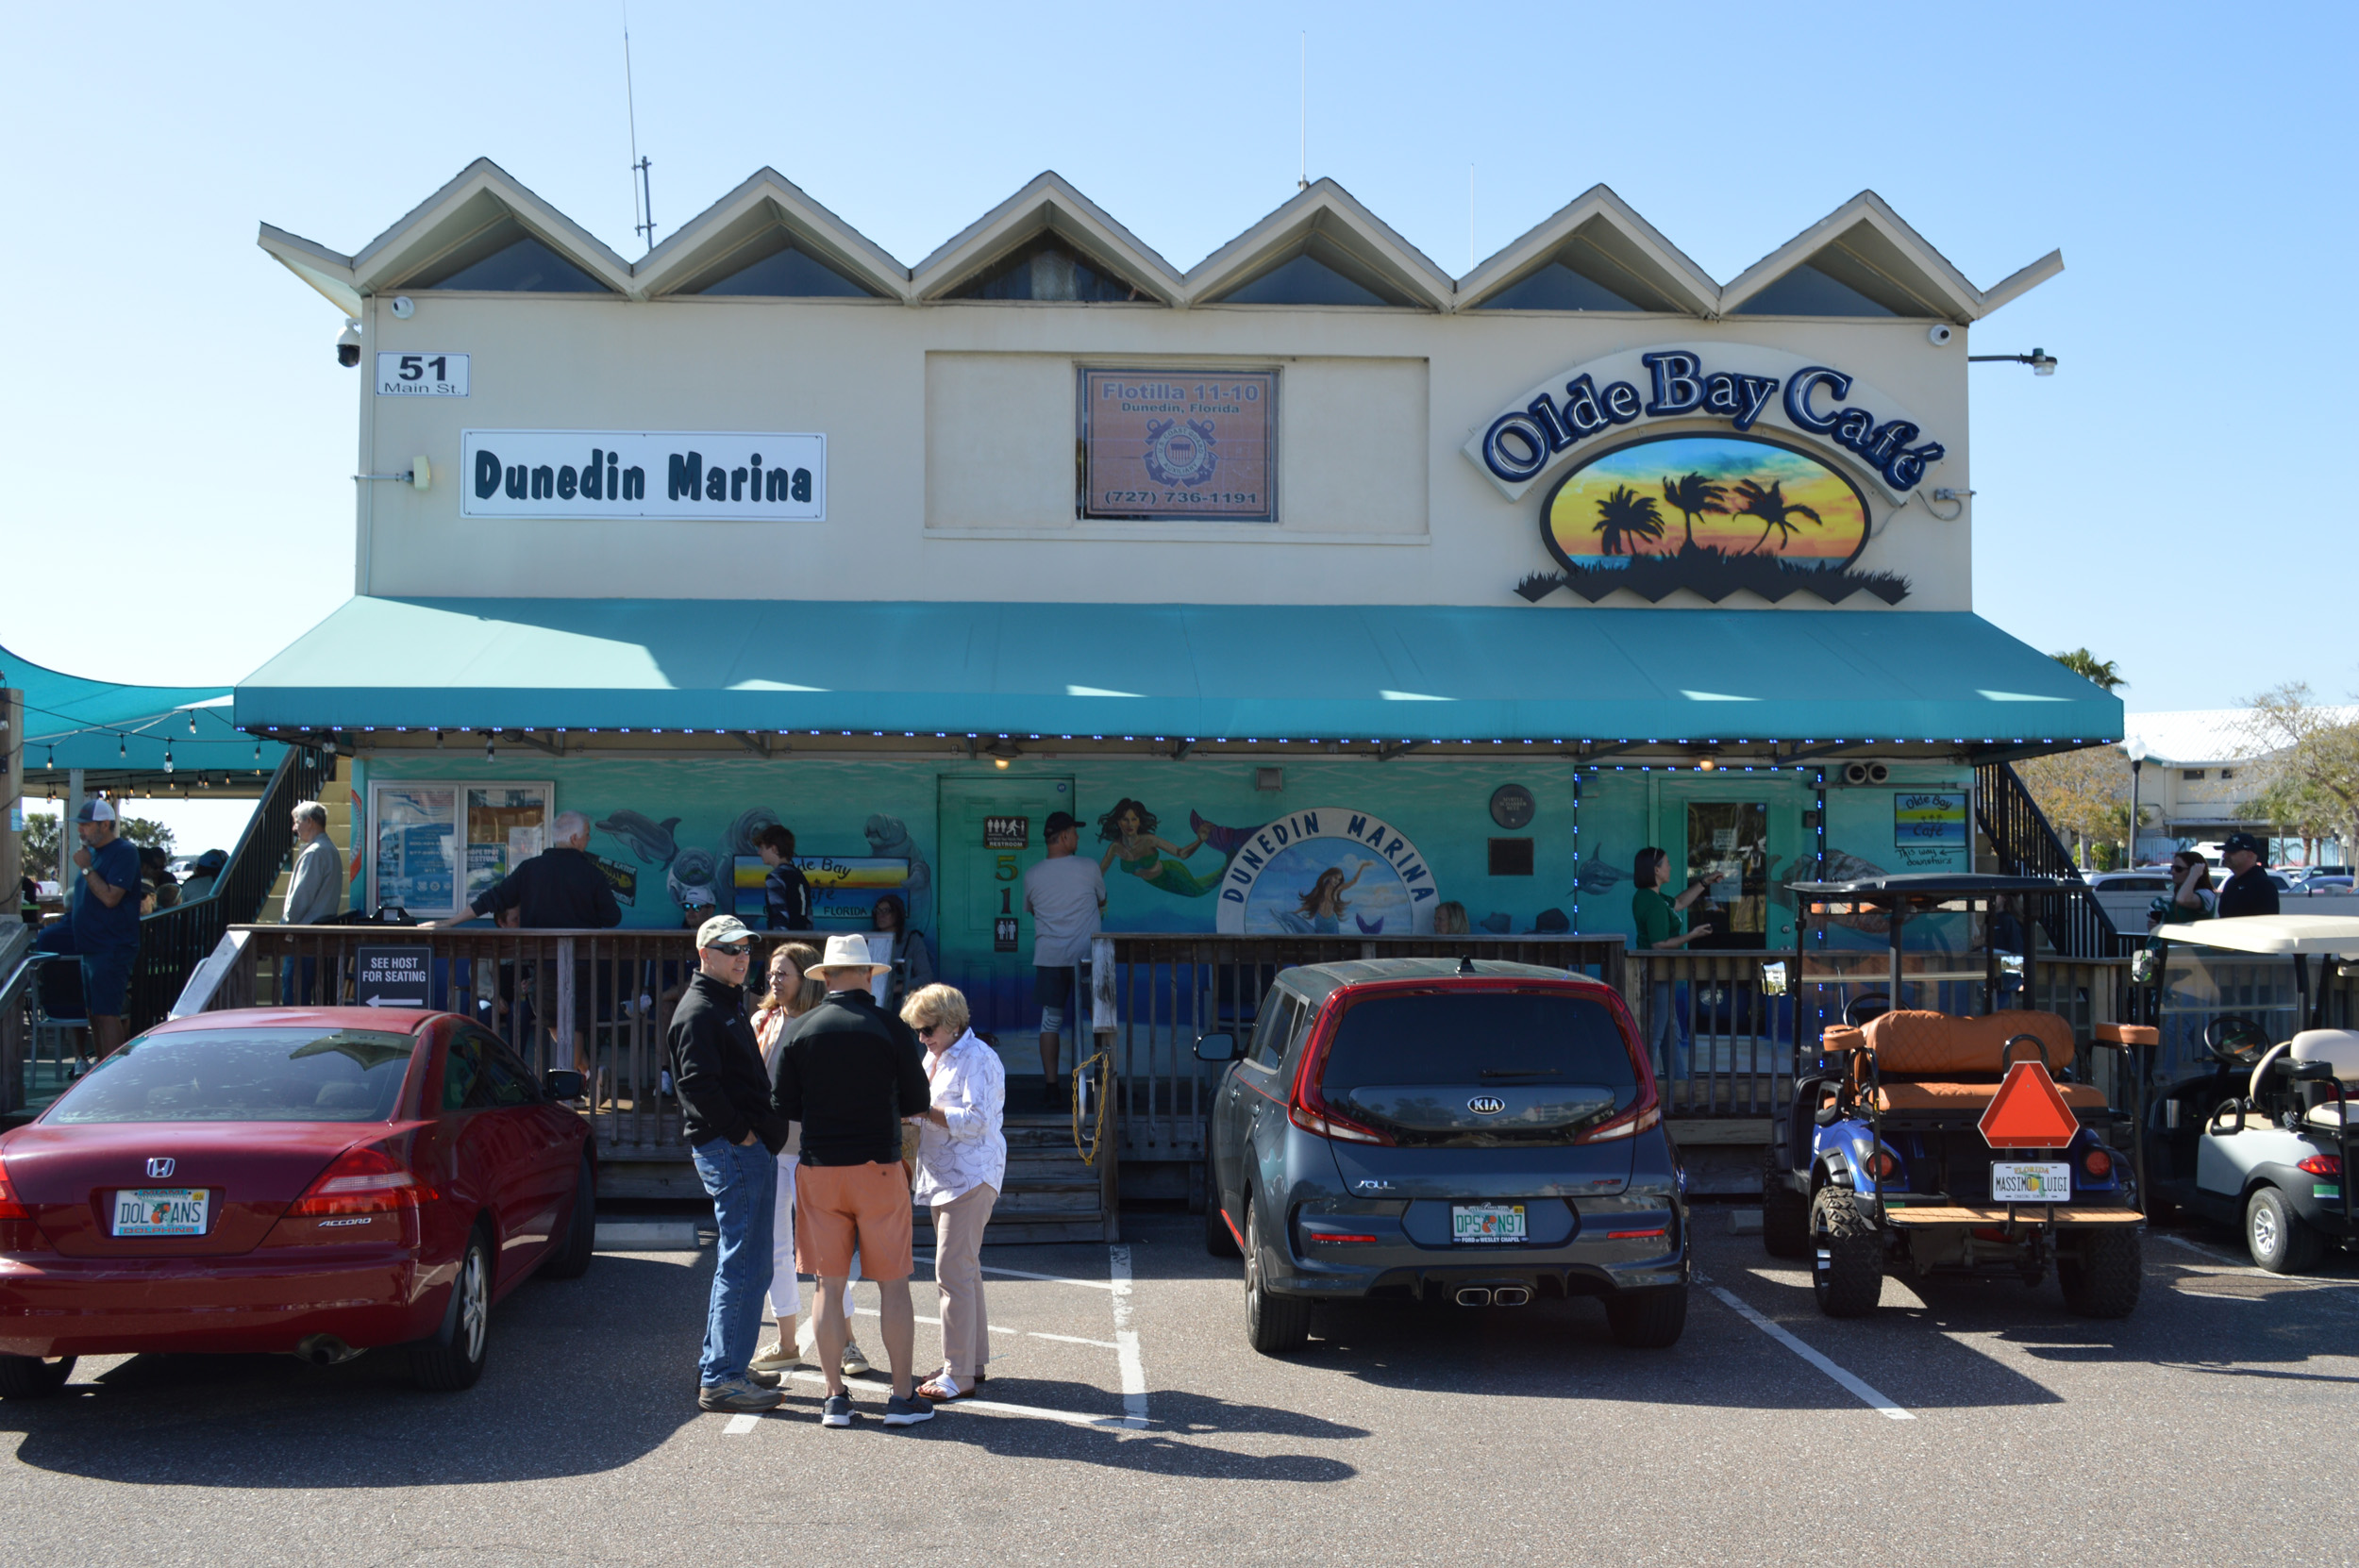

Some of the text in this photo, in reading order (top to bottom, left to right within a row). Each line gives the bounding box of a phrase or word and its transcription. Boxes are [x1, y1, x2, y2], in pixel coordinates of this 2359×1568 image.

[398, 356, 446, 381] 51
[384, 382, 460, 393] Main St.
[1102, 382, 1260, 403] Flotilla 11-10
[1121, 402, 1240, 414] Dunedin, Florida
[1482, 350, 1946, 492] Olde Bay Café
[1163, 427, 1187, 440] COAST
[475, 448, 811, 503] Dunedin Marina
[1104, 491, 1258, 505] (727) 736-1191
[1906, 793, 1953, 810] Olde Bay
[1222, 811, 1435, 904] DUNEDIN MARINA
[1895, 847, 1937, 859] This way
[822, 858, 852, 879] Bay
[824, 906, 867, 916] FLORIDA
[371, 957, 418, 969] SEE HOST
[362, 971, 427, 982] FOR SEATING
[1474, 1098, 1499, 1110] KIA
[1996, 1176, 2067, 1192] MASSIMO LUIGI
[317, 1217, 372, 1227] ACCORD
[1456, 1214, 1522, 1232] DPS N97
